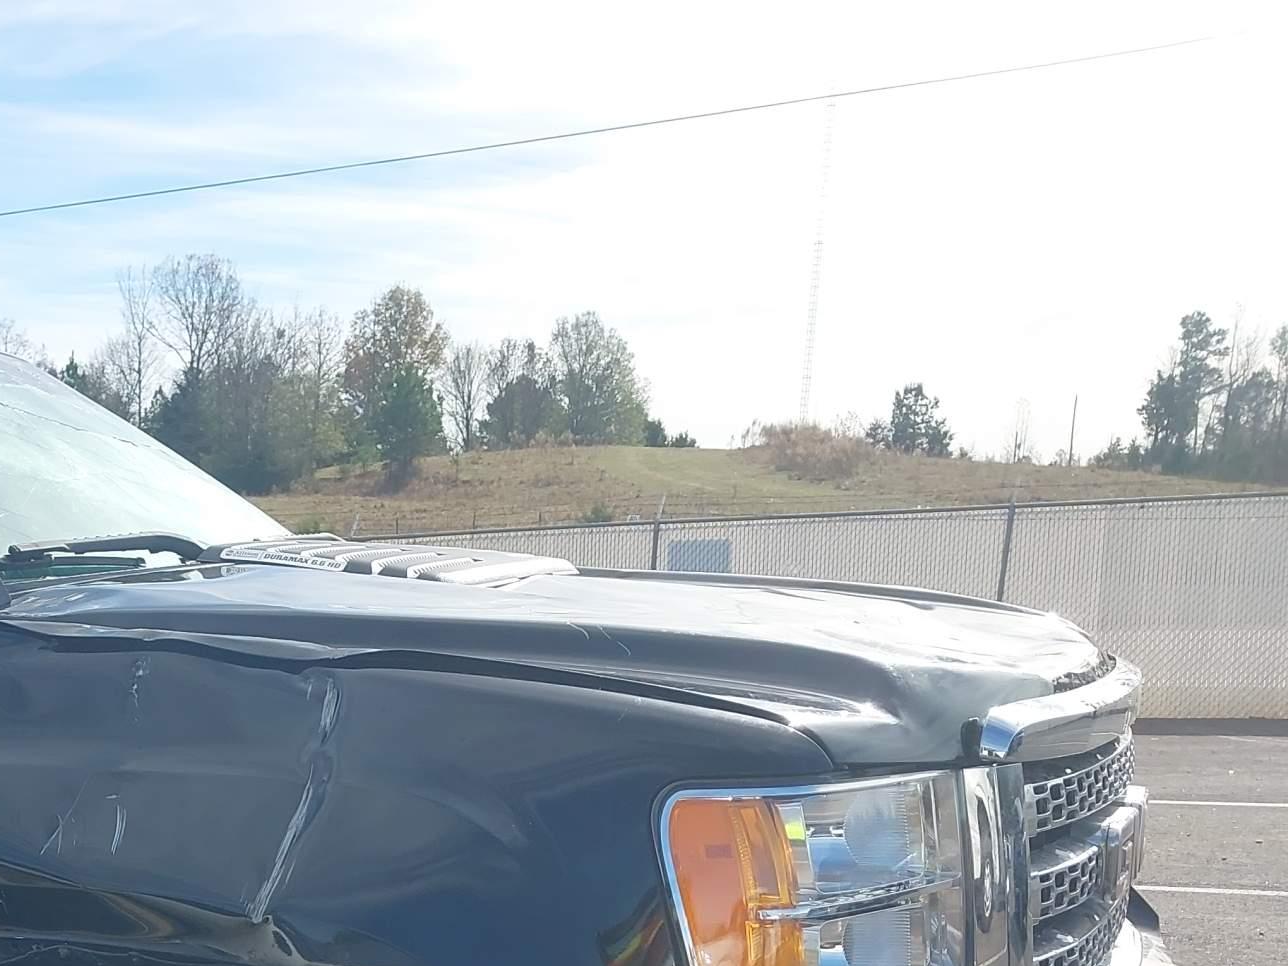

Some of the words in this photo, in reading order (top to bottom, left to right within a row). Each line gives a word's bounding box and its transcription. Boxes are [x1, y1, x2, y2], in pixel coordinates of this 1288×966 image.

[264, 553, 310, 565] DURAMAX
[312, 559, 325, 567] 6.6
[327, 561, 342, 569] HD
